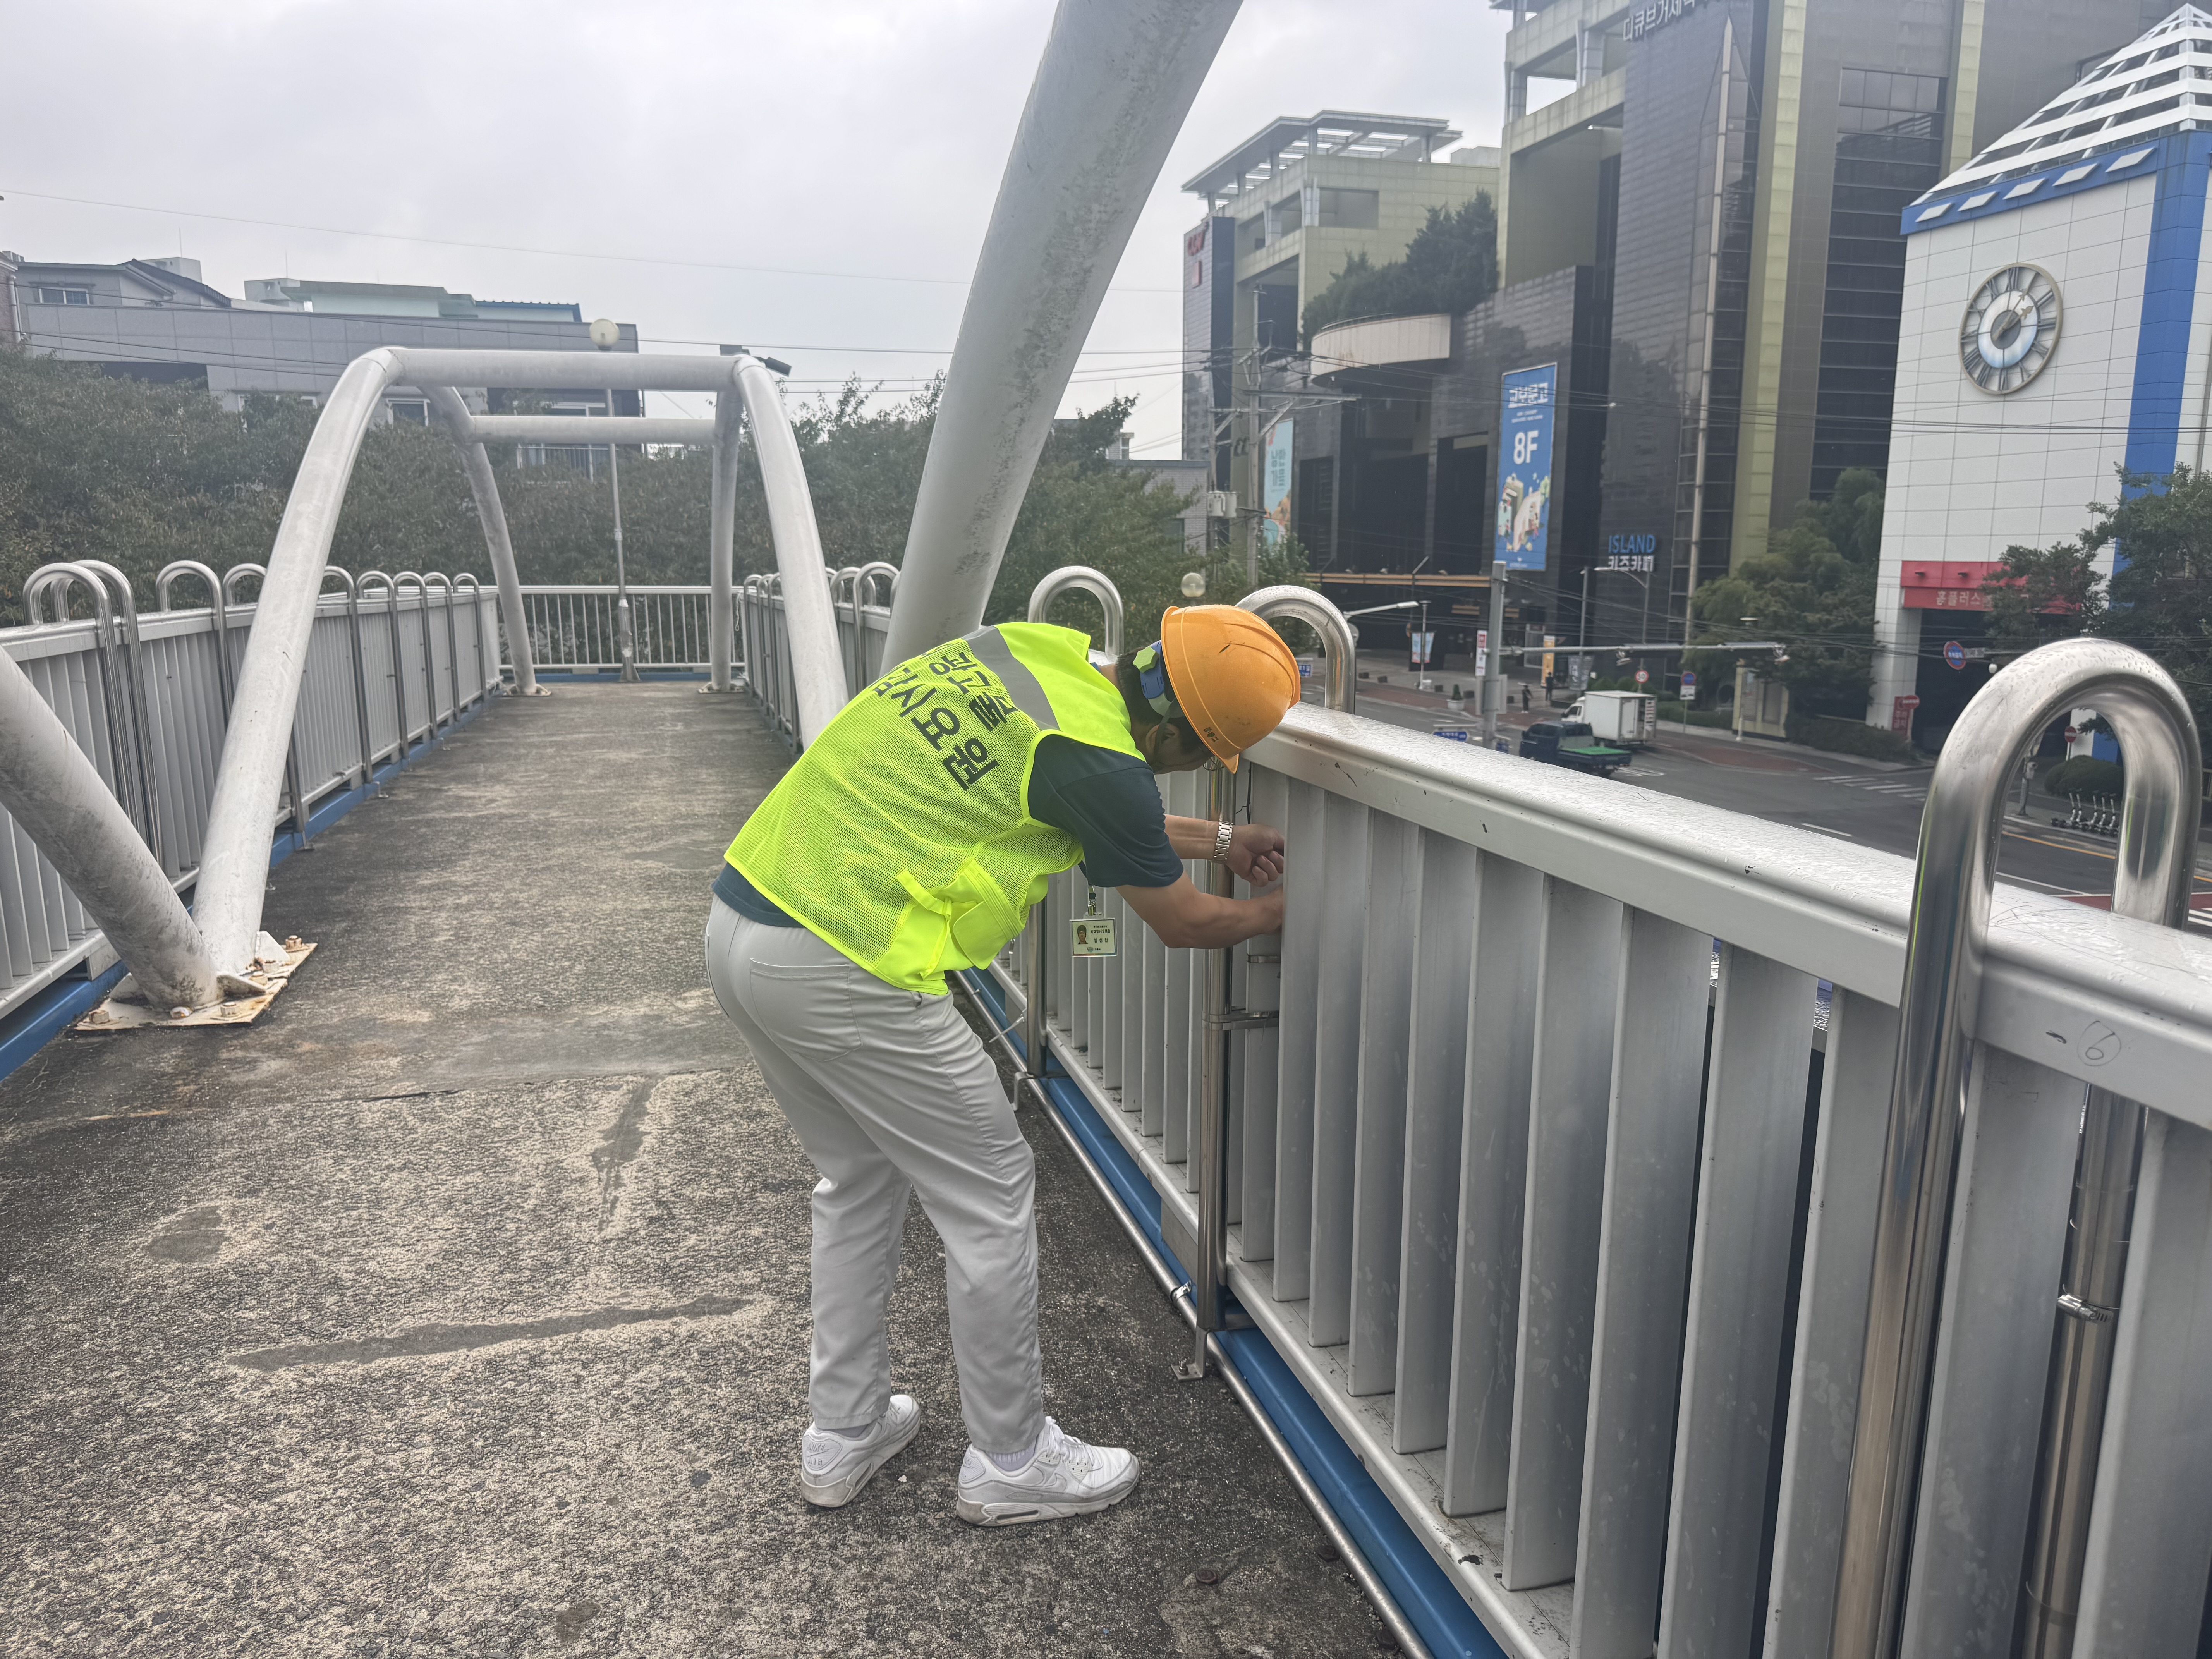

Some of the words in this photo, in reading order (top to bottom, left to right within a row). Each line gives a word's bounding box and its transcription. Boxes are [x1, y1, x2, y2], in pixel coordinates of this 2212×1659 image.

[1508, 383, 1548, 409] 교보문고
[1513, 430, 1539, 465] 8F
[1609, 534, 1655, 554] ISLAND
[867, 663, 999, 791] 감시요원
[807, 1442, 826, 1452] NIKE
